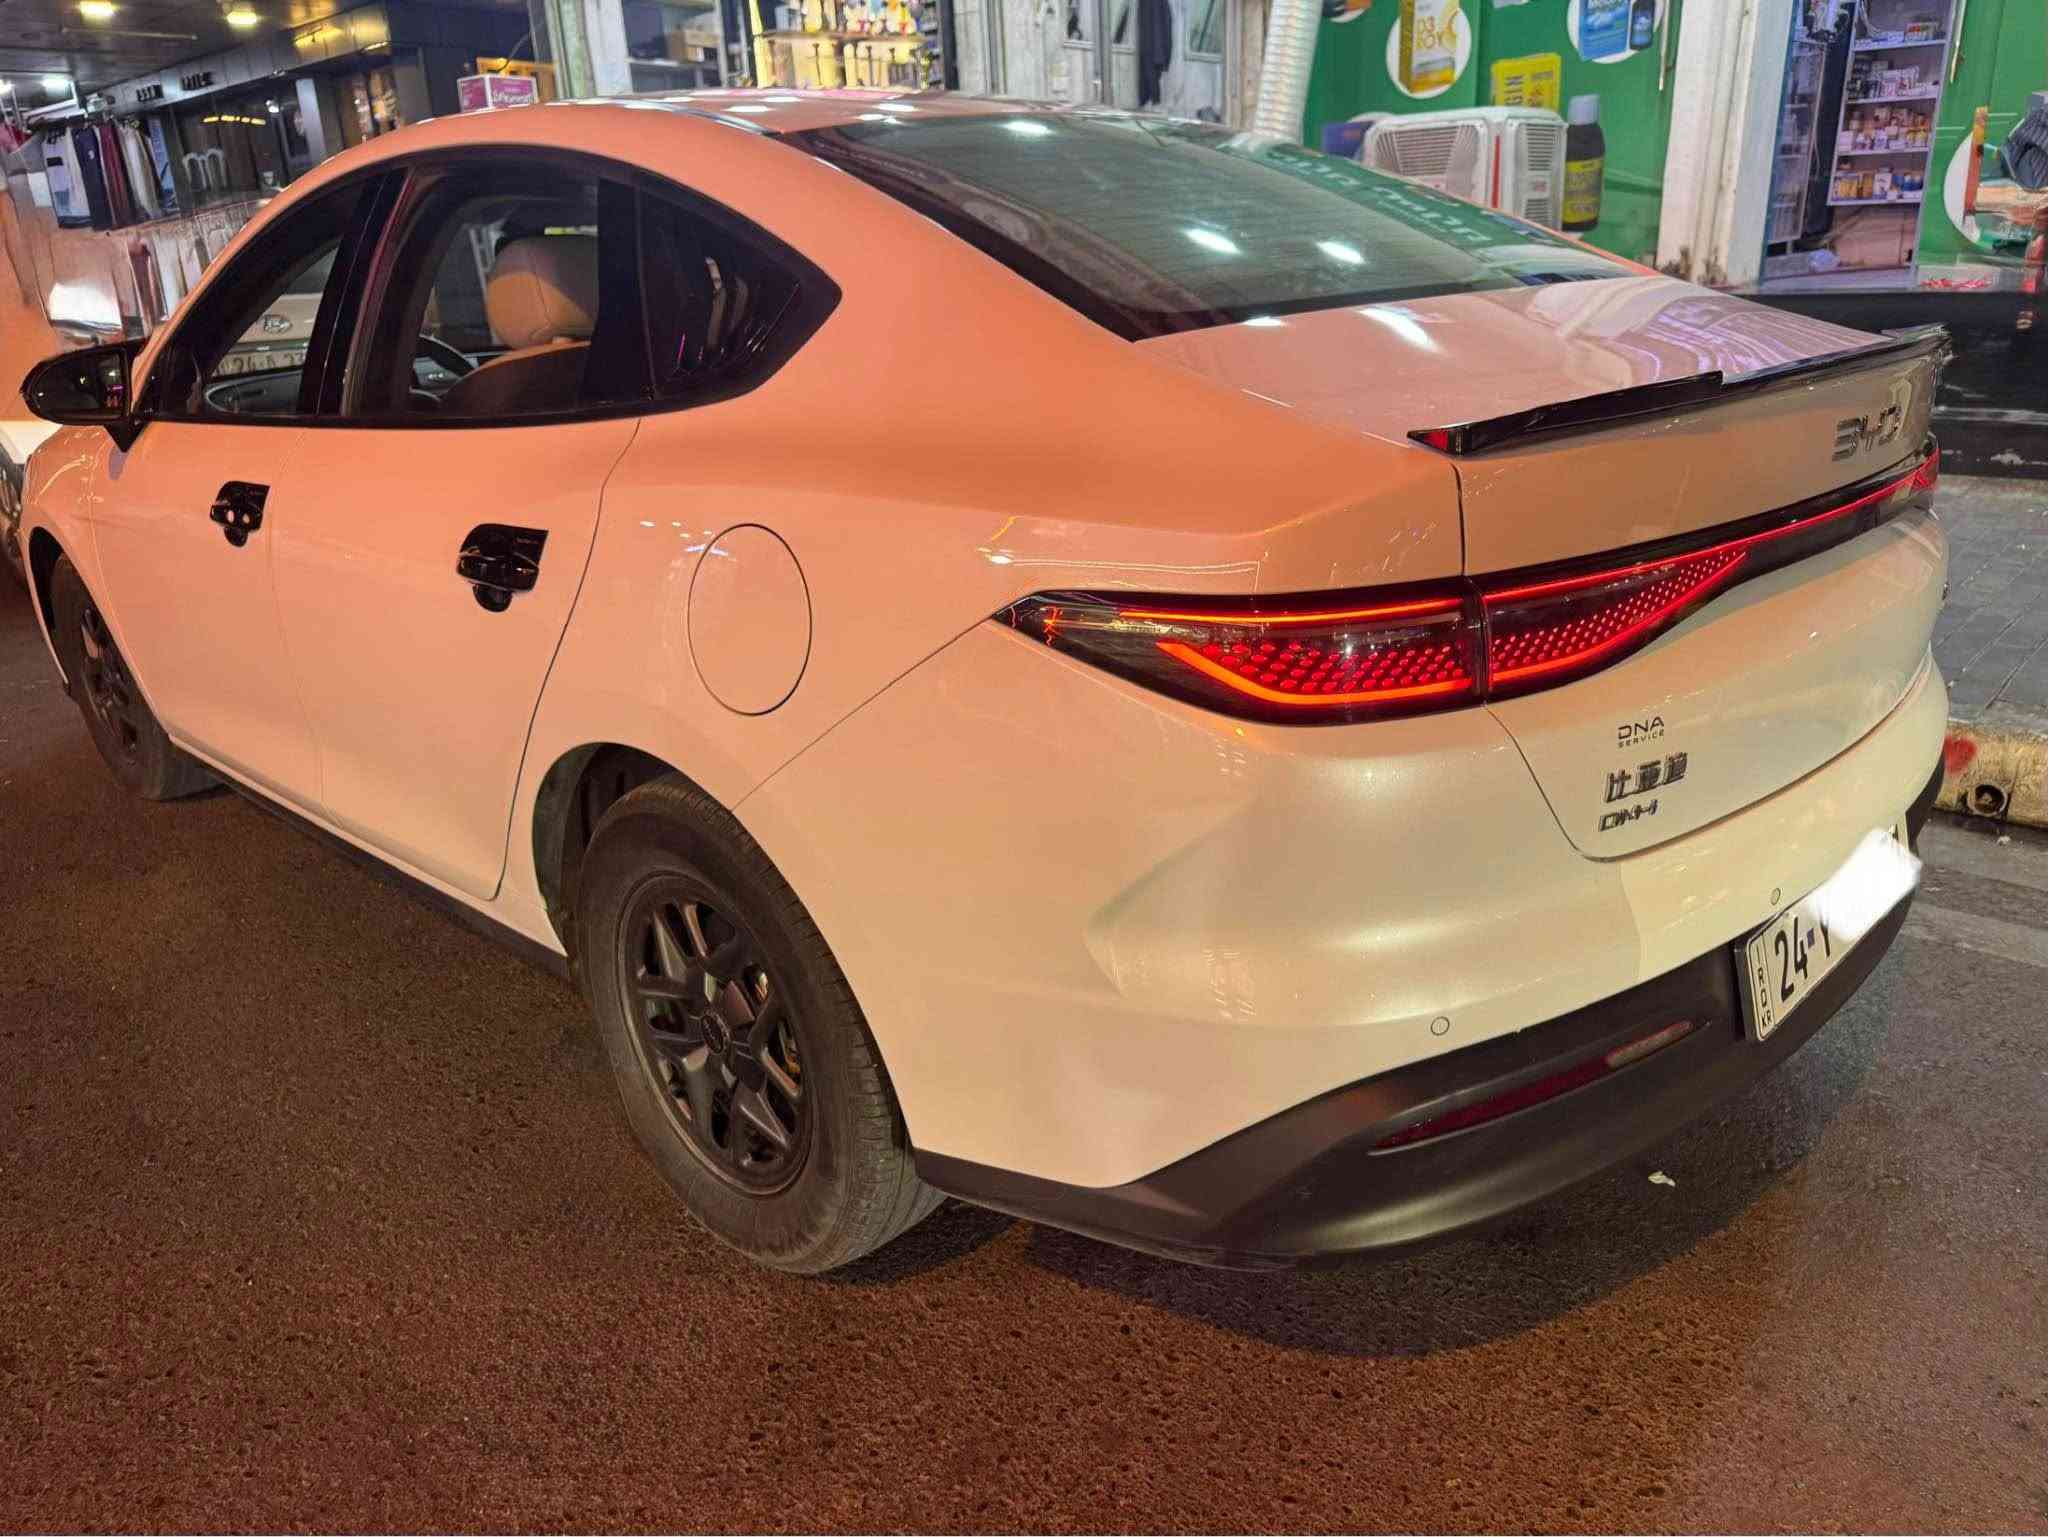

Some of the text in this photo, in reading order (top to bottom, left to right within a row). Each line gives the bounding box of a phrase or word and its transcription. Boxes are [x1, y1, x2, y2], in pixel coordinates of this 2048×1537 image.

[1832, 405, 1903, 462] BYD
[1617, 716, 1665, 740] DNA
[1617, 728, 1665, 749] SERVICE
[1760, 1008, 1774, 1028] KR
